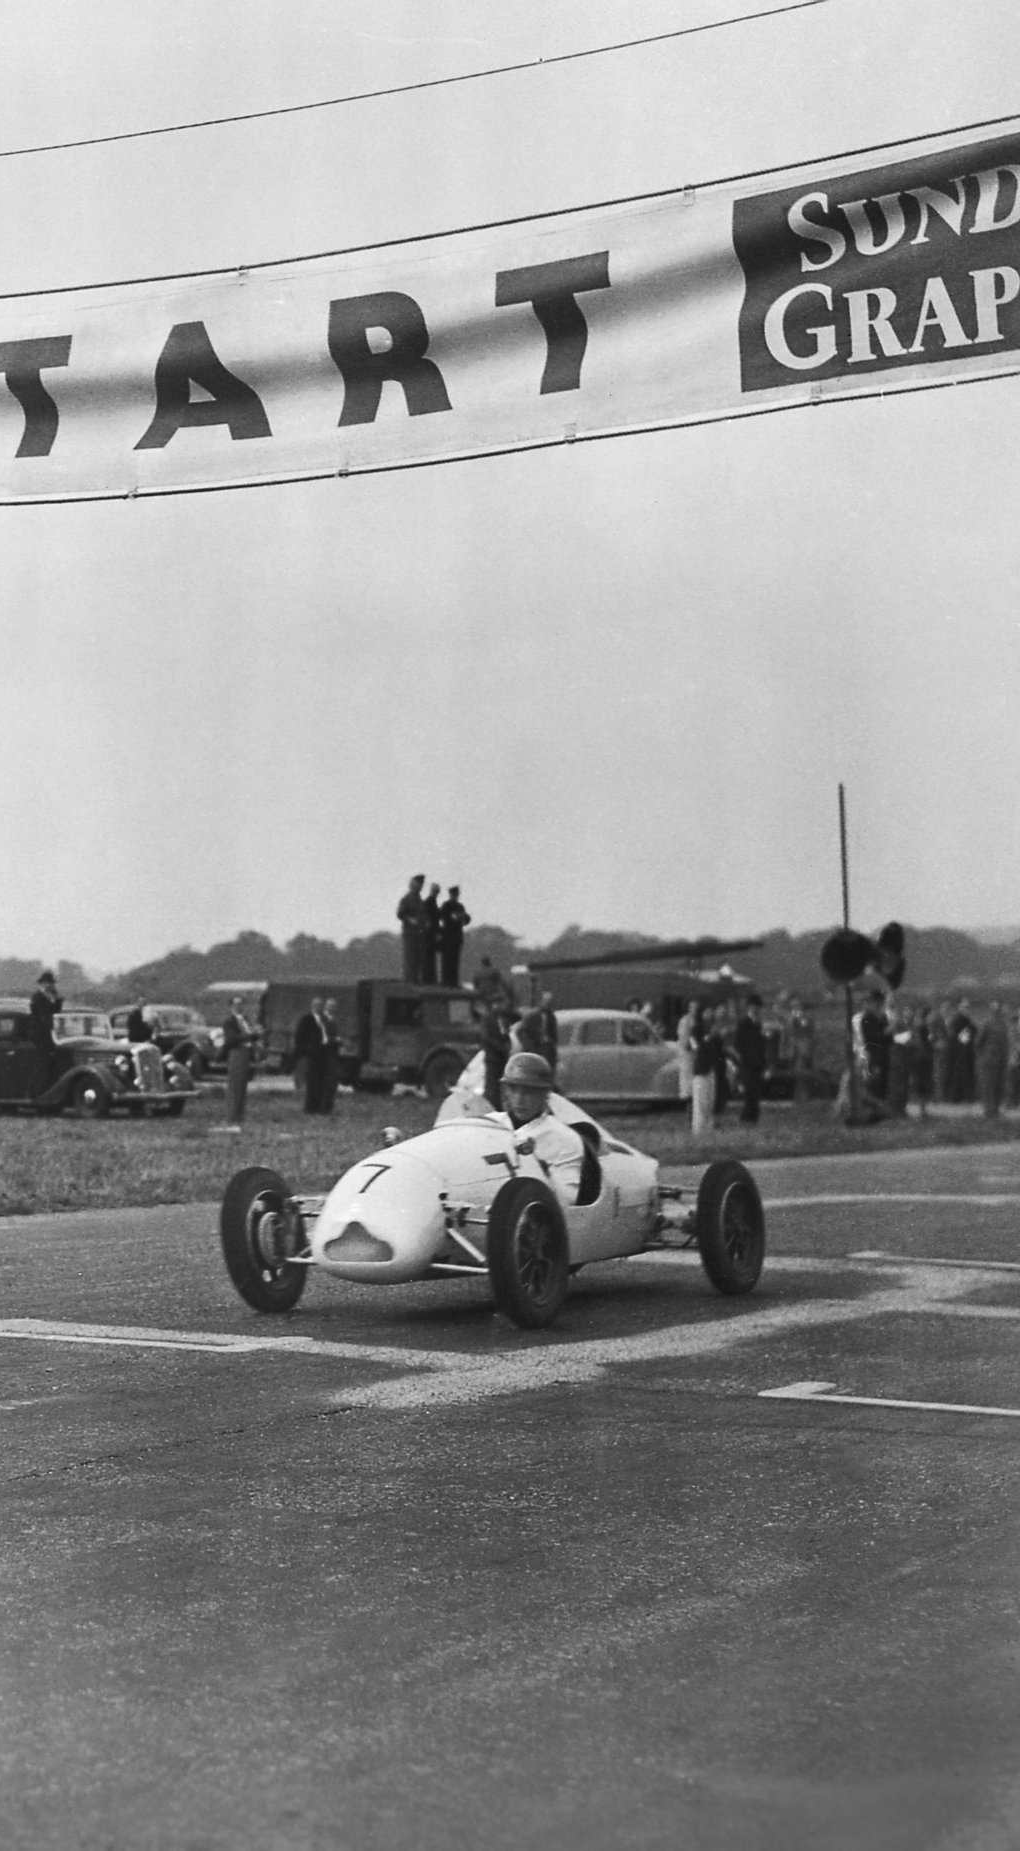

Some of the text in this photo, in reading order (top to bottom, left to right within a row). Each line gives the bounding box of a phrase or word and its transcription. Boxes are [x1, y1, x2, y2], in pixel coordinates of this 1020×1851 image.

[787, 164, 1020, 272] SUND
[764, 266, 1020, 370] GRAP
[360, 1164, 392, 1193] 7
